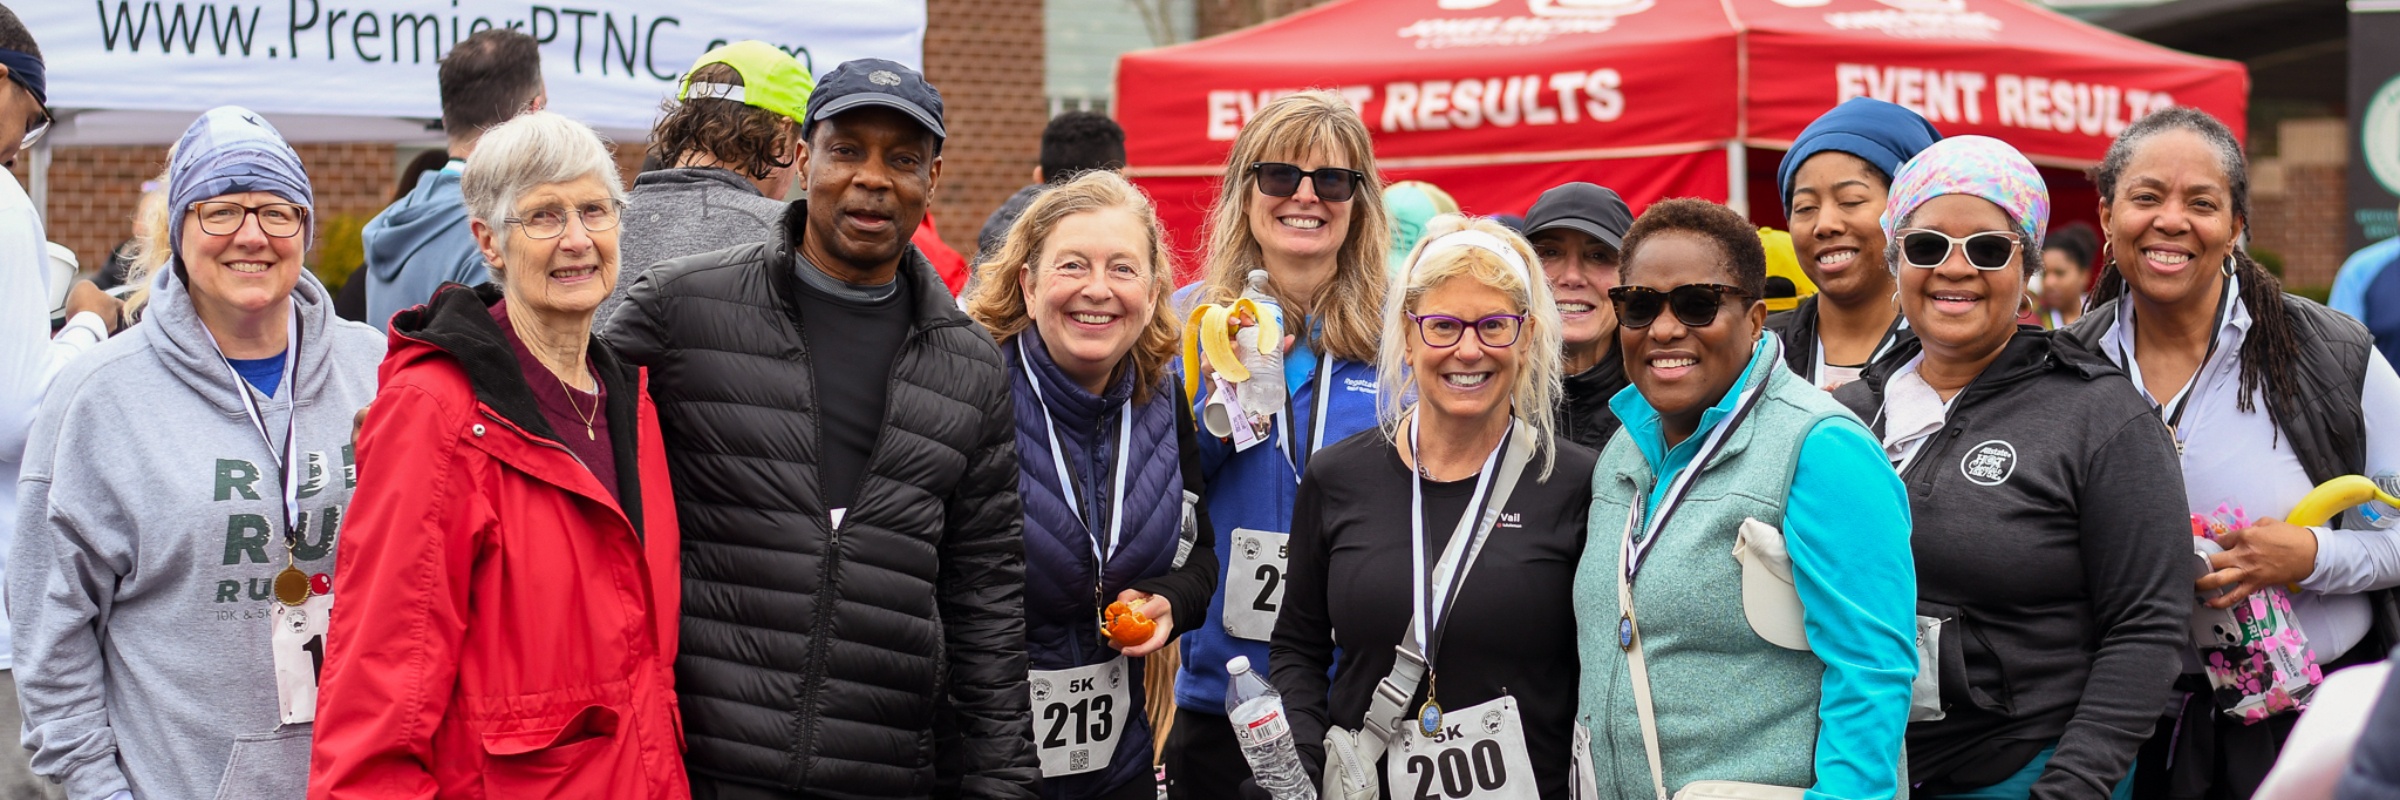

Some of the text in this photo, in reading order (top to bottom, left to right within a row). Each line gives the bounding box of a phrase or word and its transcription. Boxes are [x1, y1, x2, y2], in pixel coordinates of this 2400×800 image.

[98, 0, 813, 80] www.PremiPTNC
[1207, 69, 1625, 140] EVT RESULTS
[1836, 63, 1987, 125] EVENT
[214, 443, 356, 501] RU
[1500, 513, 1520, 522] Vail
[214, 608, 271, 621] 10K & 5K
[1252, 563, 1288, 613] 2
[302, 633, 328, 688] 1
[1069, 677, 1095, 694] 5K
[1042, 693, 1114, 750] 213
[1432, 723, 1464, 743] 5K
[1406, 738, 1508, 800] 200
